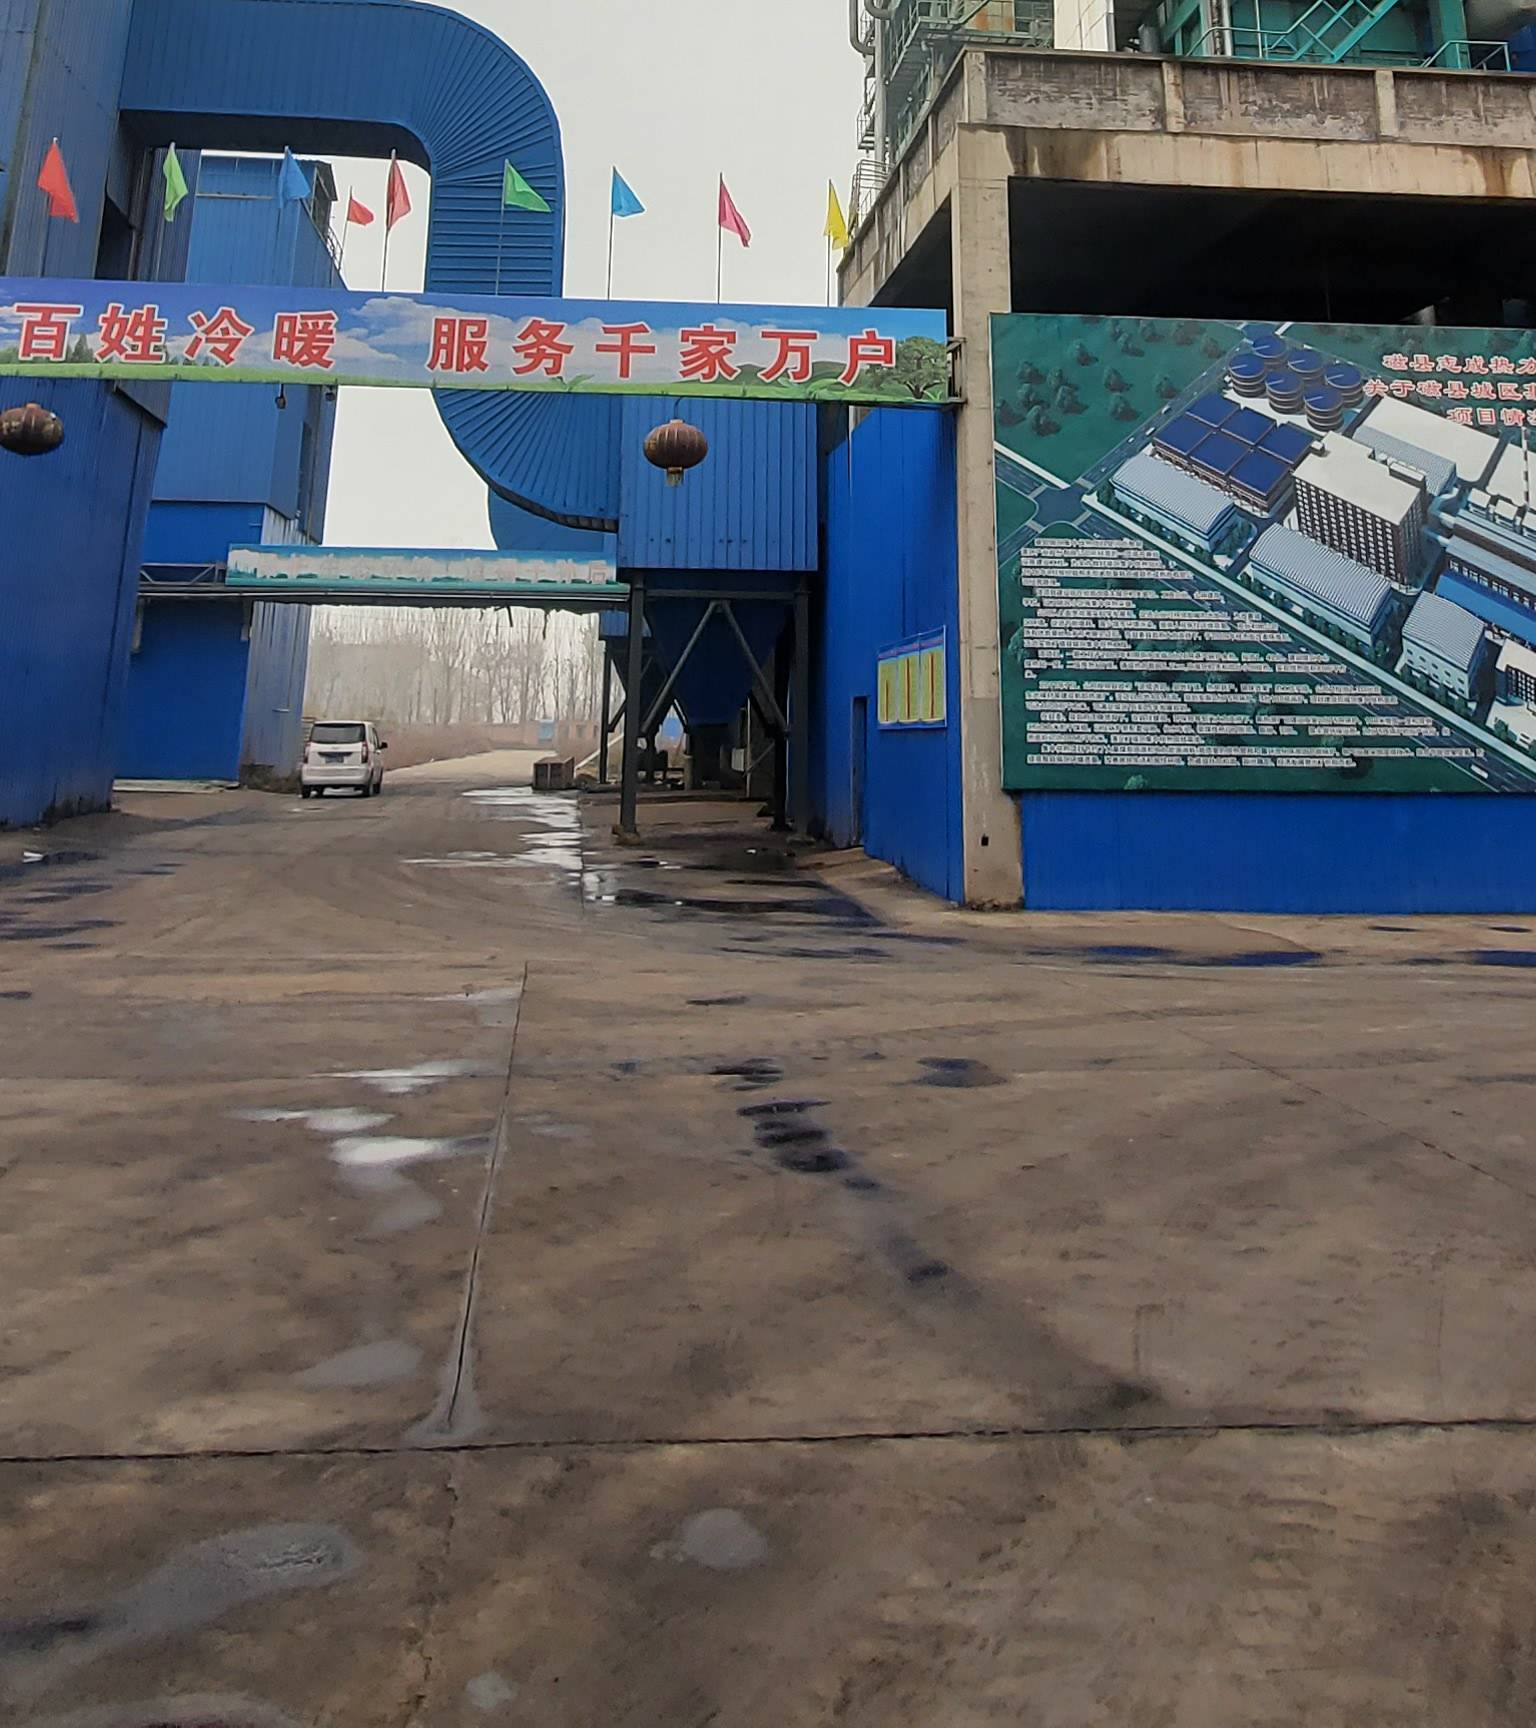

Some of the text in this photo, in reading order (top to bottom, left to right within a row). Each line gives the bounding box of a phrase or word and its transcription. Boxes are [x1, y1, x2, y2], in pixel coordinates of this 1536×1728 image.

[426, 315, 898, 387] 服务千家万户
